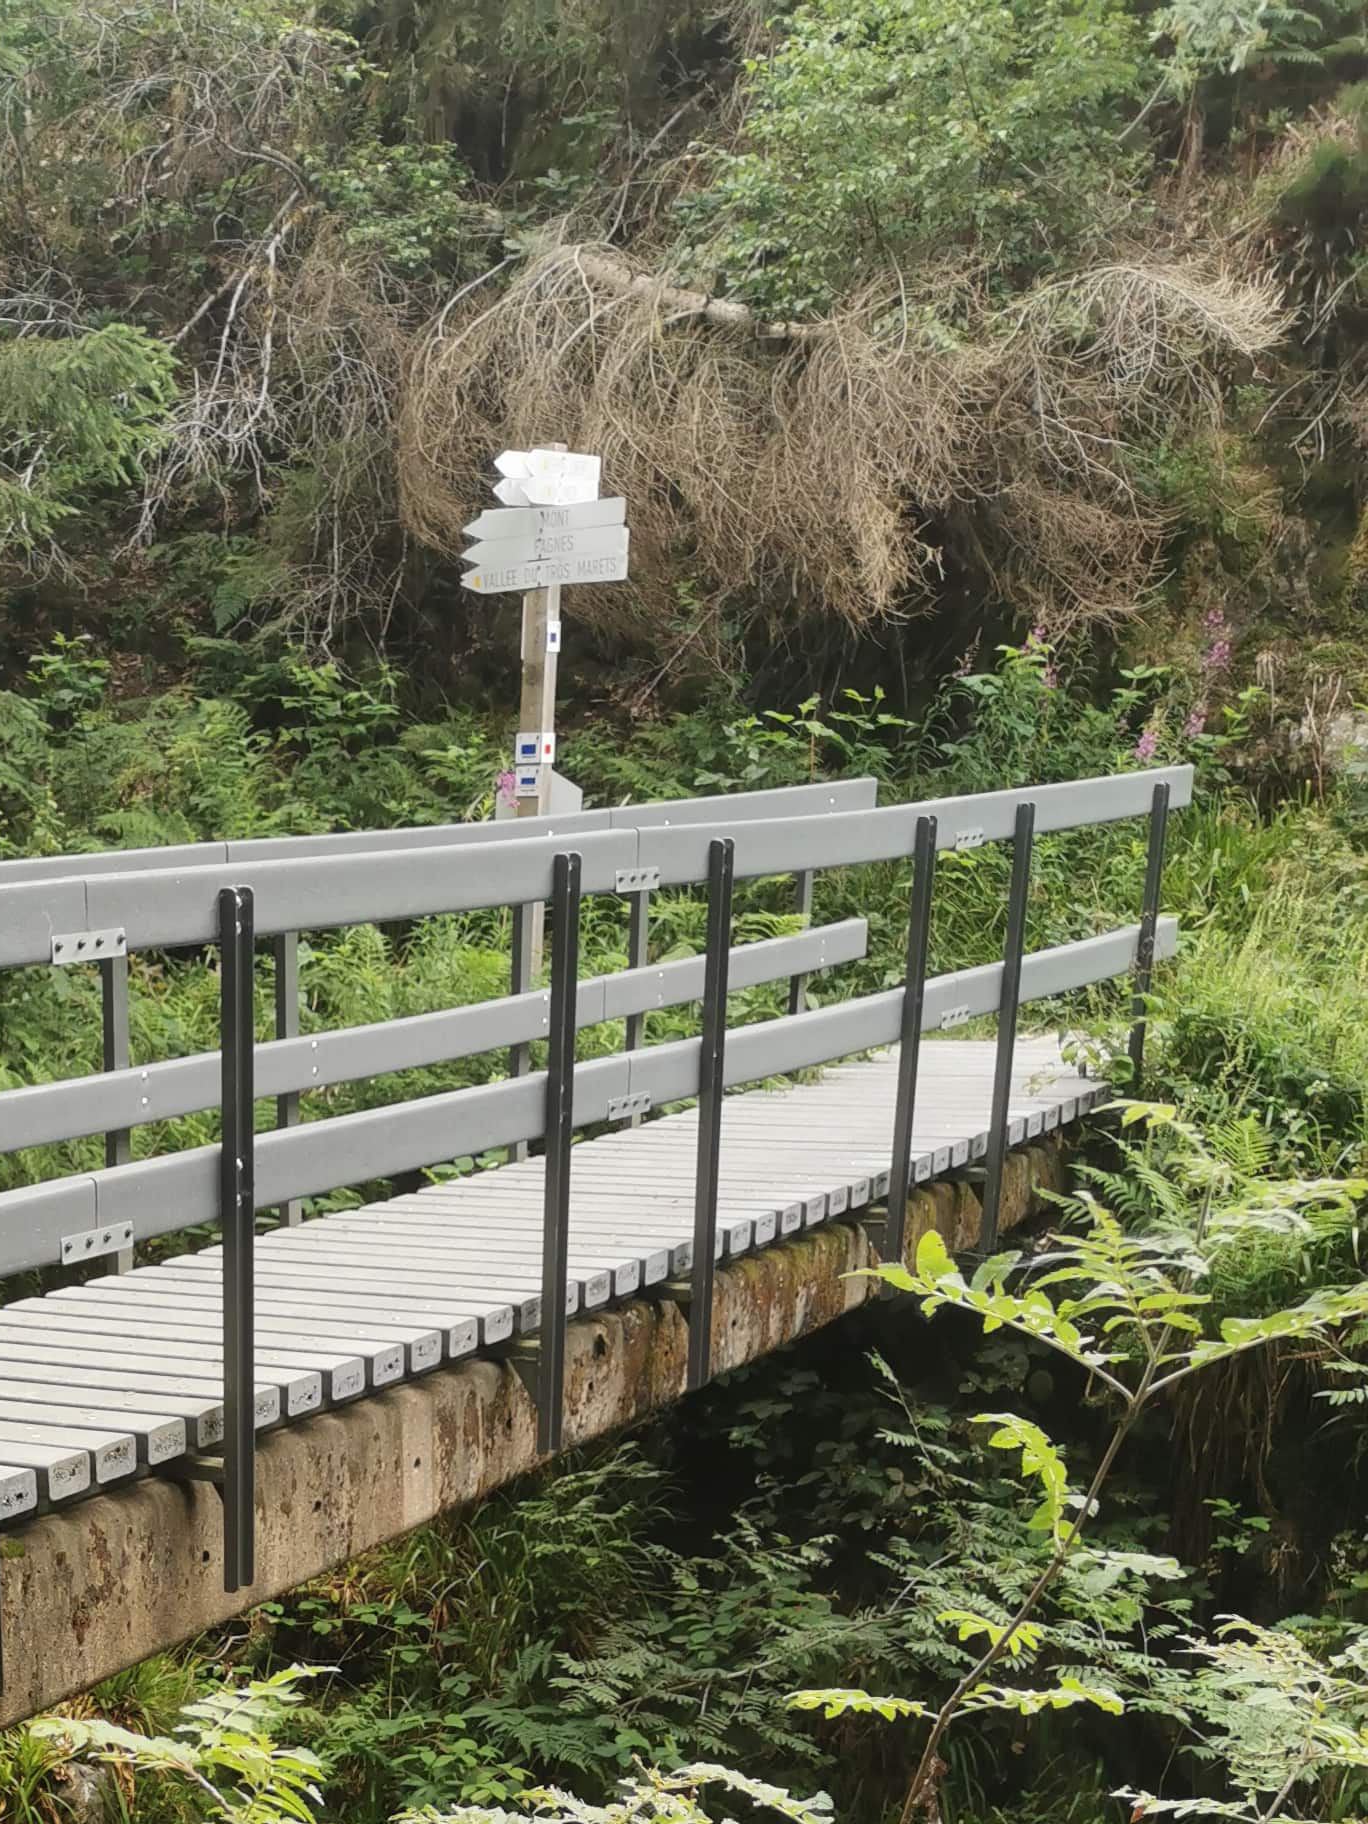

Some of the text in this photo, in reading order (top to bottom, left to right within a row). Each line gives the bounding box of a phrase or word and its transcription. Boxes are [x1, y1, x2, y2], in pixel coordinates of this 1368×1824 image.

[540, 510, 570, 528] MONT
[535, 535, 574, 553] FAGNES
[524, 567, 538, 585] DU
[577, 557, 617, 577] MARETS
